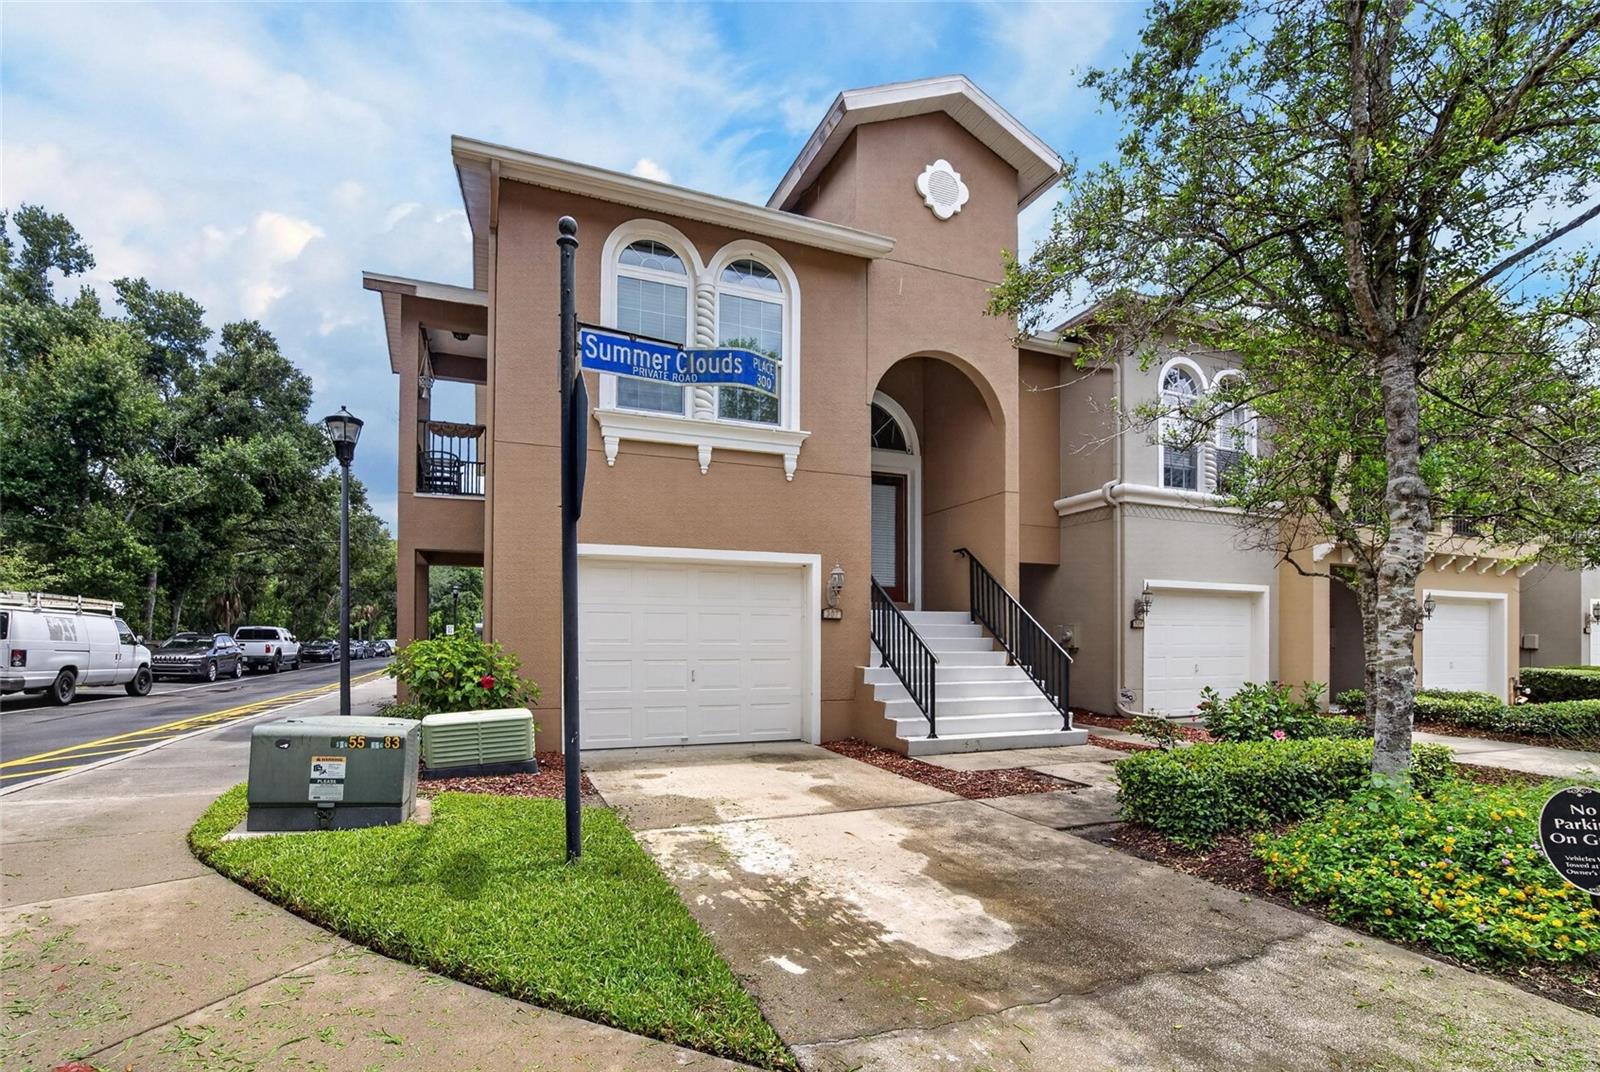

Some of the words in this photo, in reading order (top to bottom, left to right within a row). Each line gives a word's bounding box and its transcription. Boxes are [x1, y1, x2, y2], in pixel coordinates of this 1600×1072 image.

[585, 334, 671, 372] Summer
[676, 353, 743, 374] Clouds
[753, 357, 775, 376] PLACE
[632, 366, 669, 382] PRIVATE
[672, 373, 698, 383] ROAD
[756, 374, 772, 389] 300
[348, 735, 366, 749] 55
[383, 735, 400, 749] 83
[1570, 804, 1597, 816] No
[1550, 832, 1578, 844] On
[1565, 855, 1596, 863] Vehicles
